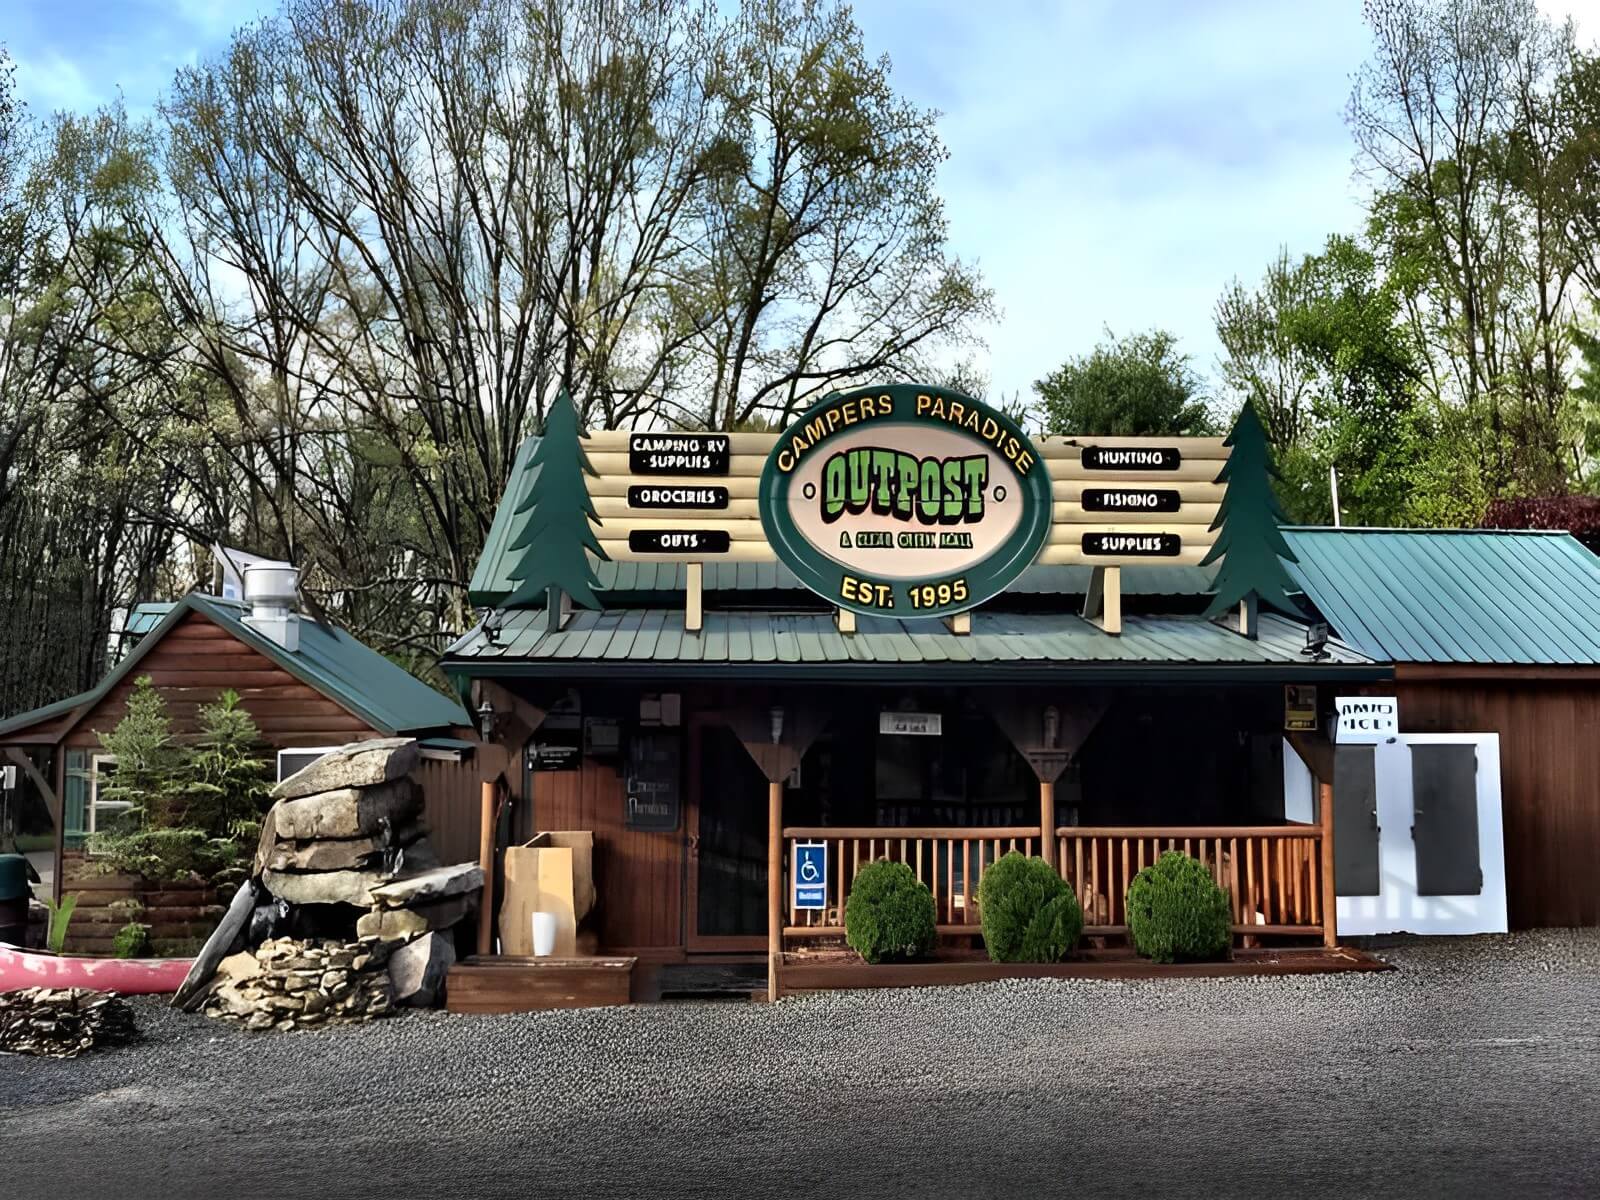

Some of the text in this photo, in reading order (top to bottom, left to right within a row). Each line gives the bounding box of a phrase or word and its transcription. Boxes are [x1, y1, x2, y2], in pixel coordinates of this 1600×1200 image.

[777, 395, 1034, 475] CAMPERS PARADISE
[821, 447, 989, 525] OUTPOST
[841, 576, 967, 608] EST. 1995
